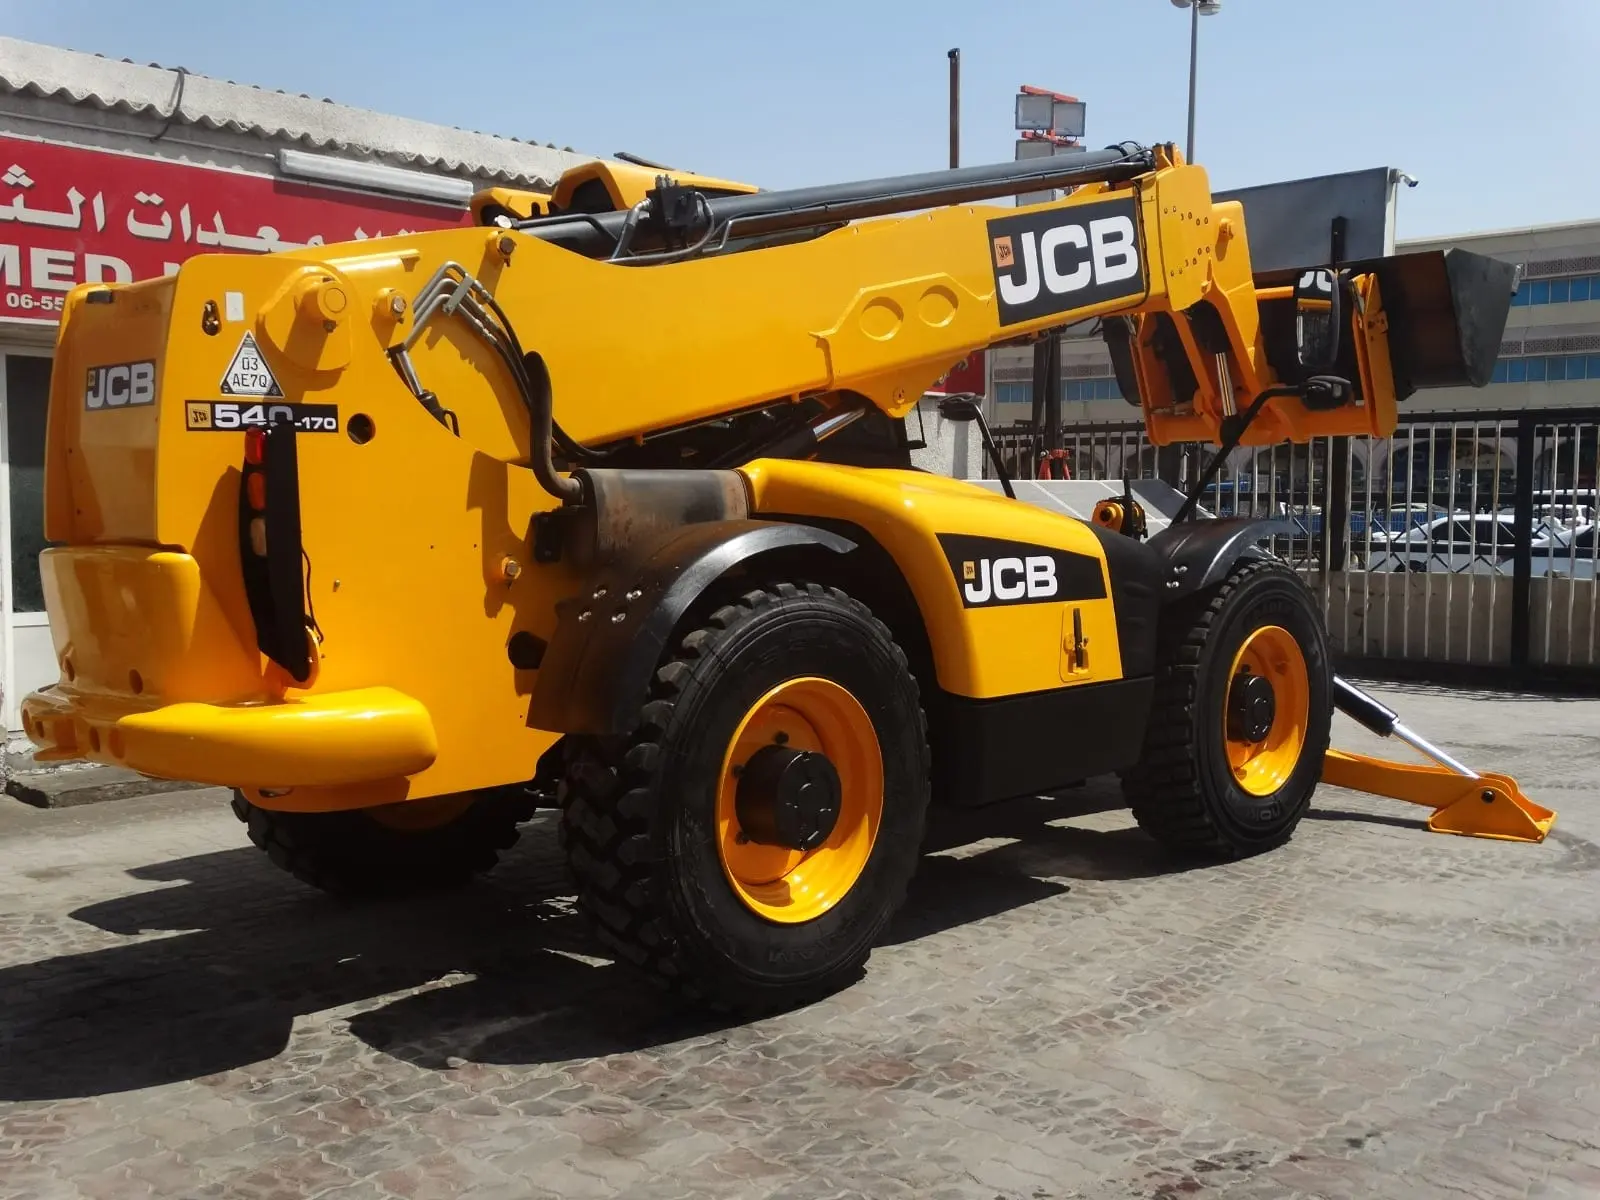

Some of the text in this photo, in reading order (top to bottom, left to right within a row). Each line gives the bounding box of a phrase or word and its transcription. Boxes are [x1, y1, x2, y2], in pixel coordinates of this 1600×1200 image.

[127, 190, 383, 253] معدات
[998, 215, 1138, 305] JCB
[87, 362, 155, 409] JCB
[232, 373, 267, 388] AE7Q
[964, 555, 1058, 603] JCB
